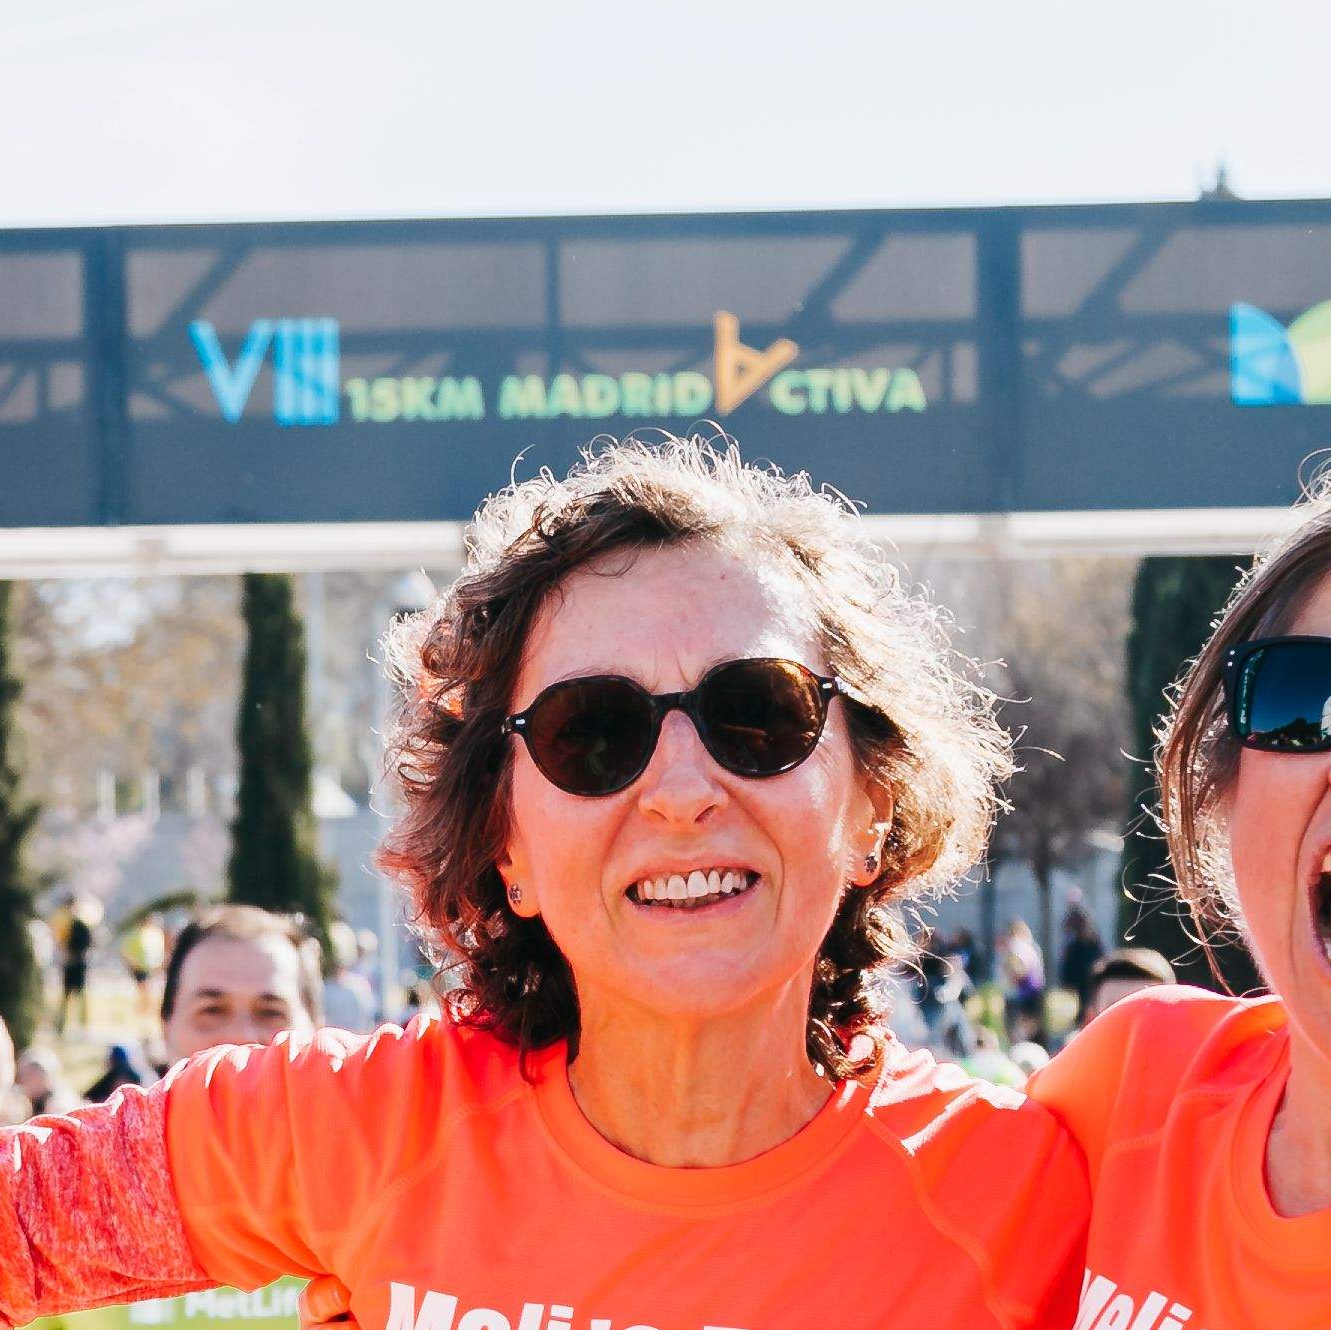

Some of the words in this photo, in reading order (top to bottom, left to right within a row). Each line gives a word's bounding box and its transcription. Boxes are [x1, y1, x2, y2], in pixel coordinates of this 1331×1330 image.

[187, 317, 340, 427] VIII
[347, 375, 484, 424] 15KM
[499, 371, 713, 420] MADRID
[185, 1287, 299, 1318] MetLif
